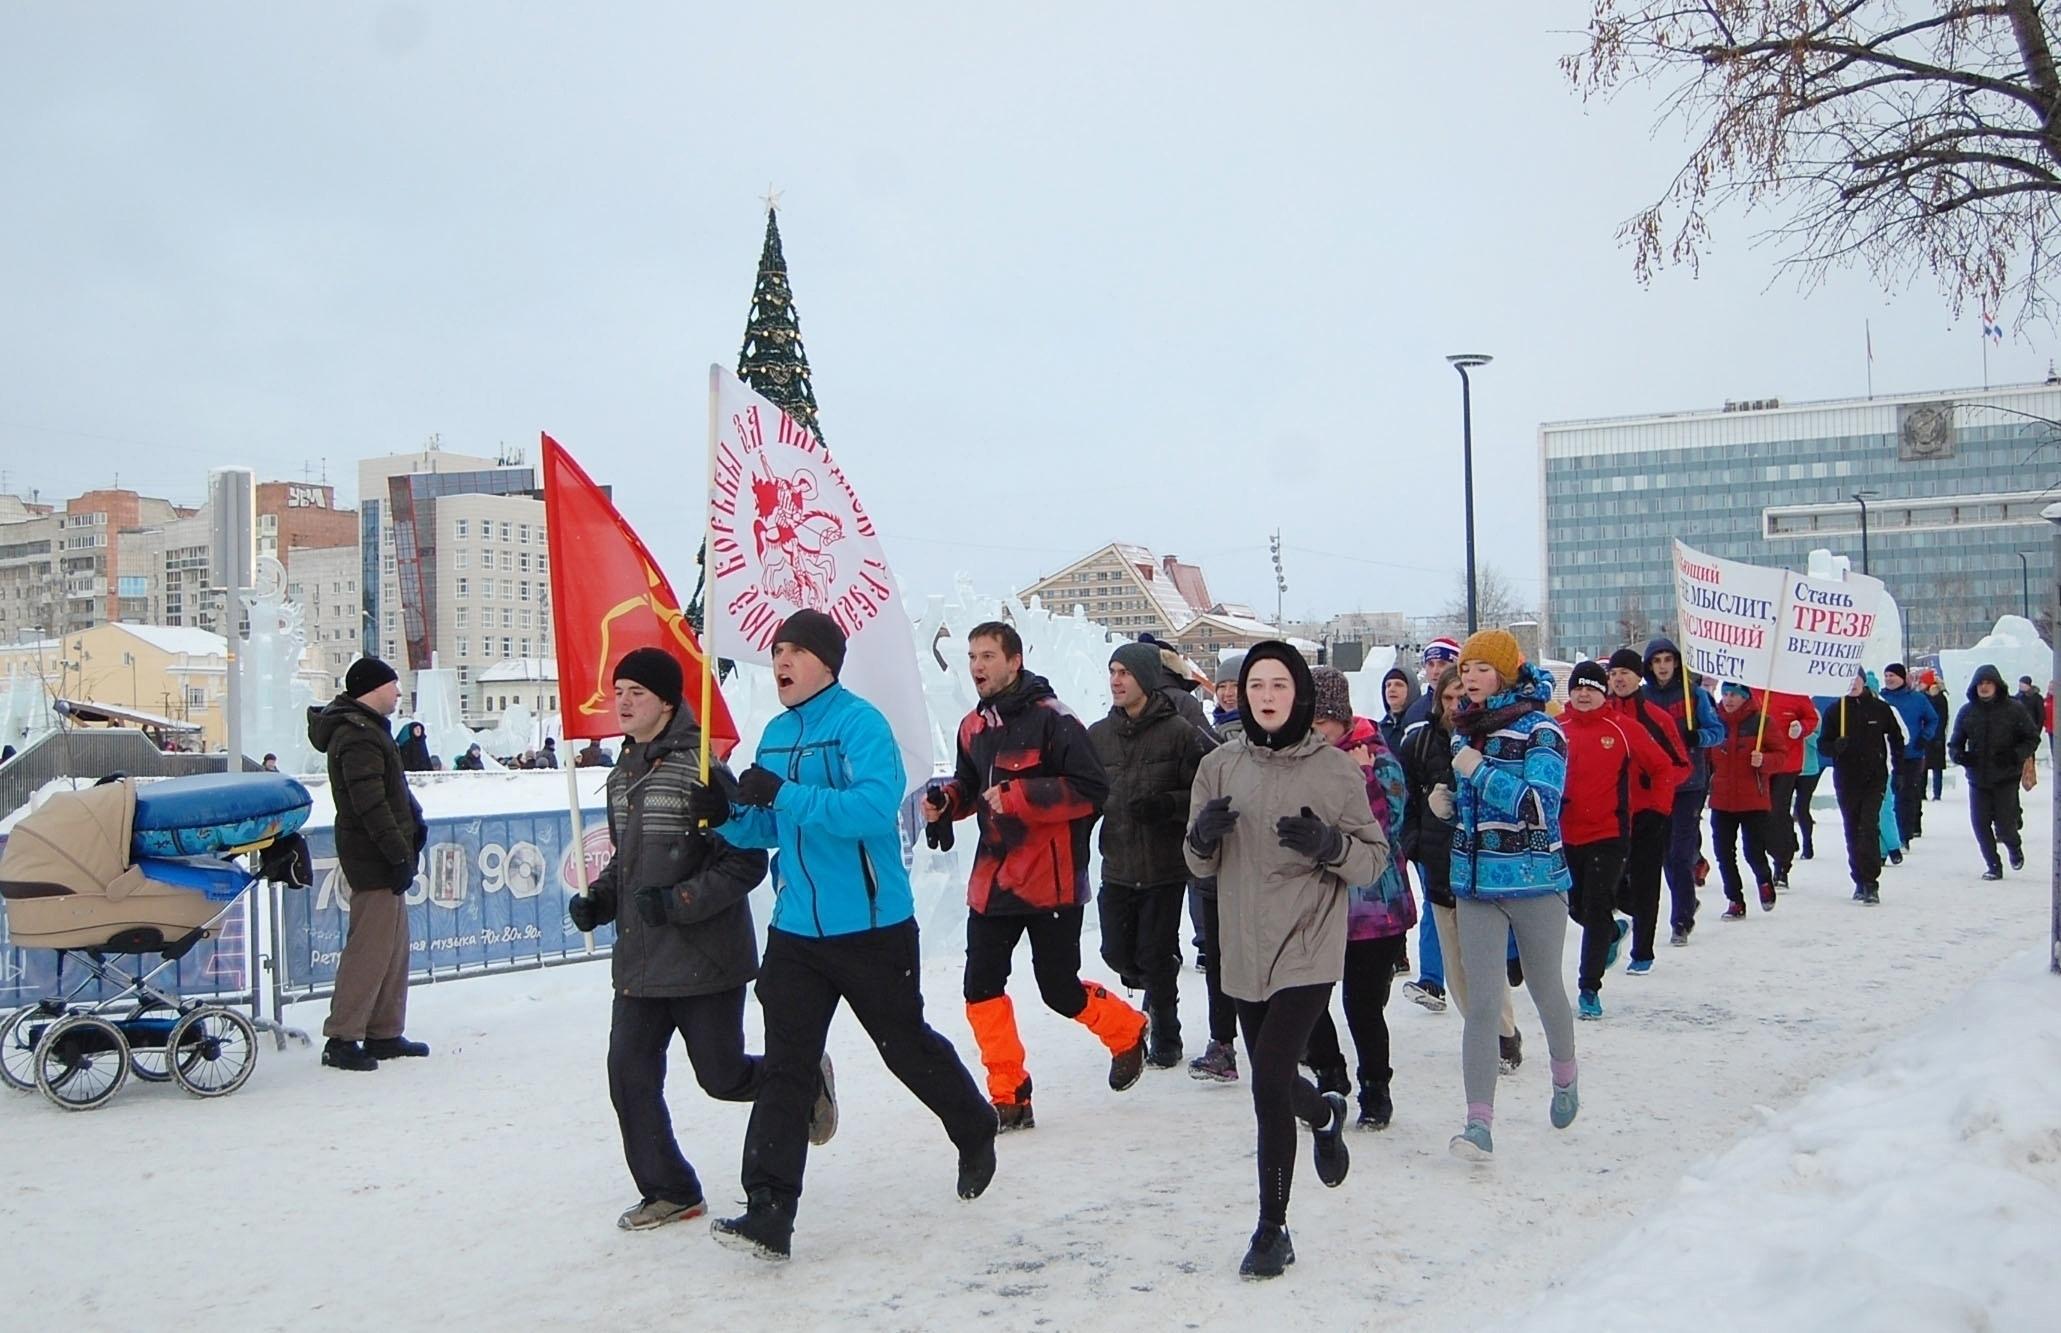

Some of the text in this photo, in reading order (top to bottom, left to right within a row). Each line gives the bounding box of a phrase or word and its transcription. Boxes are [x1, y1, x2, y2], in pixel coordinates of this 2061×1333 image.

[1690, 585, 1777, 625] МЫСЛИТ,
[1794, 582, 1853, 608] Стань
[1696, 648, 1745, 679] ПЬЁТ!
[1808, 660, 1857, 678] РУССК
[431, 935, 477, 951] музыка
